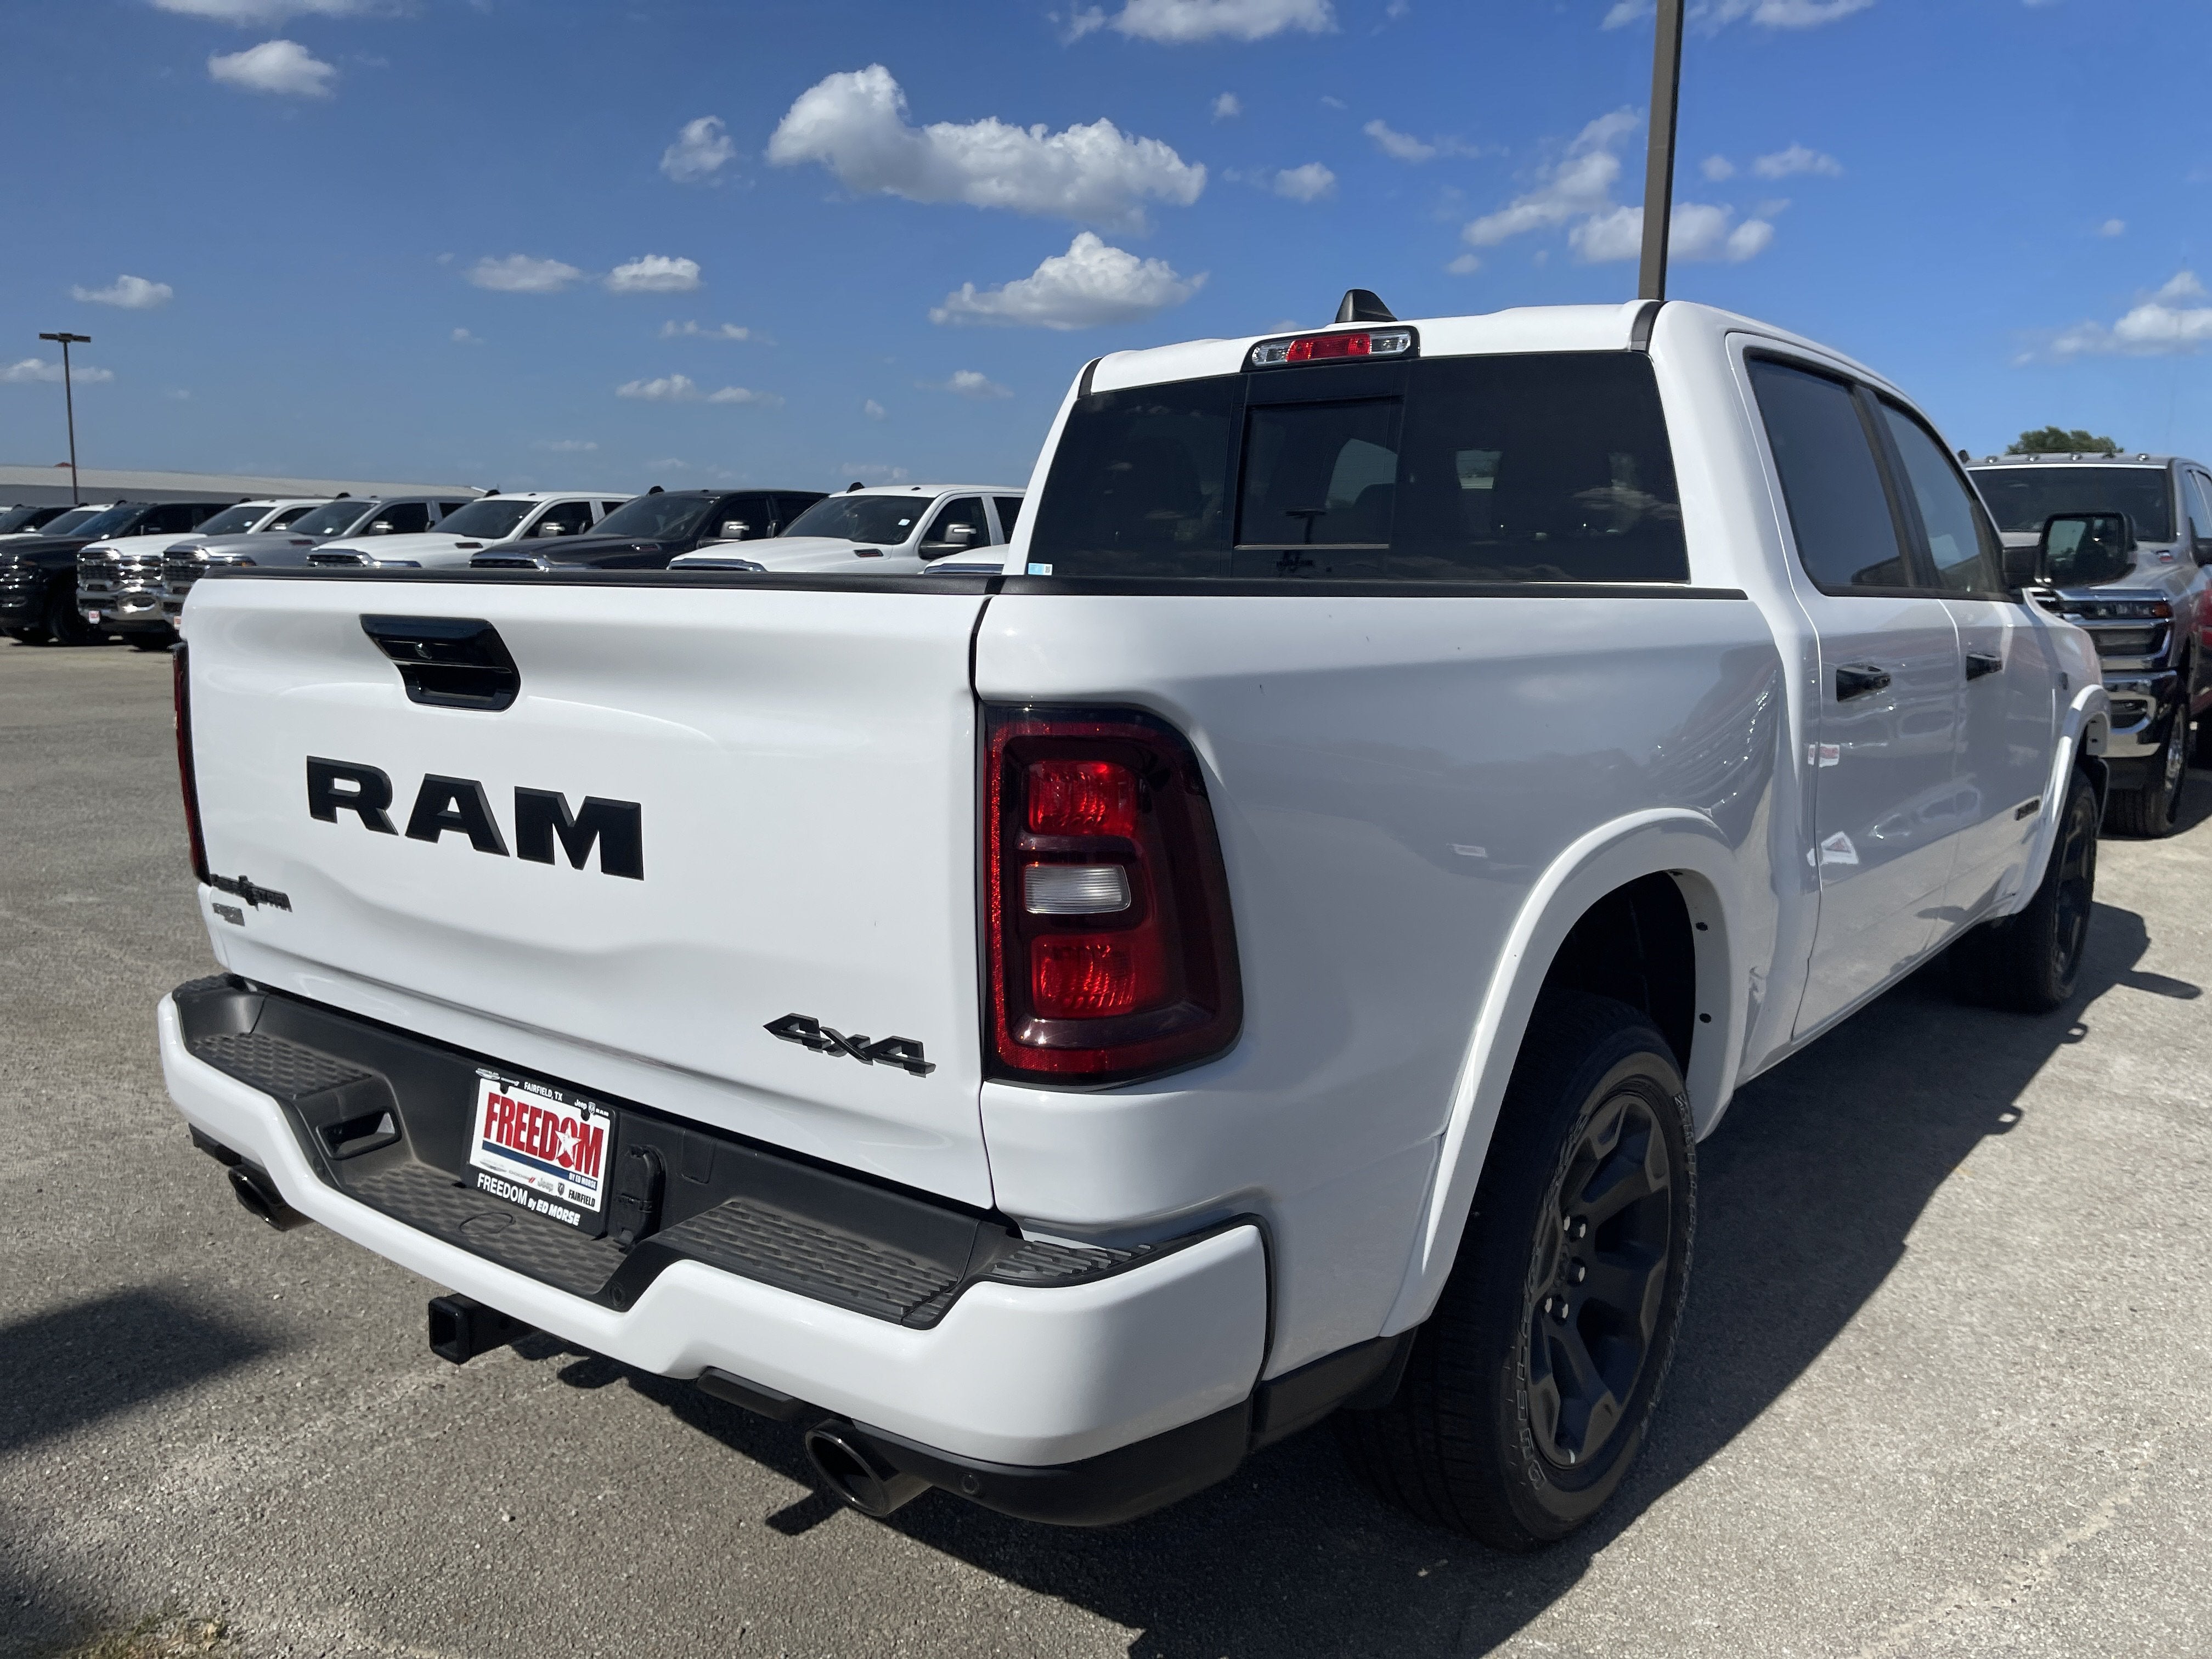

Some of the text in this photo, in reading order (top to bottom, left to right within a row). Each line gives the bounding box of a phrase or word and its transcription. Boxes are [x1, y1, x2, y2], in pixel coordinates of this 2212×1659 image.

[307, 755, 644, 881] RAM
[524, 1081, 554, 1099] FAIRFIELD,
[554, 1091, 563, 1102] TX
[574, 1099, 588, 1110] Jeep
[483, 1092, 604, 1178] FREEDOM
[575, 1174, 582, 1183] ED
[582, 1176, 597, 1189] MORSE
[477, 1172, 528, 1206] FREEDOM
[536, 1199, 549, 1214] ED
[548, 1203, 581, 1226] MORSE
[568, 1189, 596, 1207] FAIRFIELD
